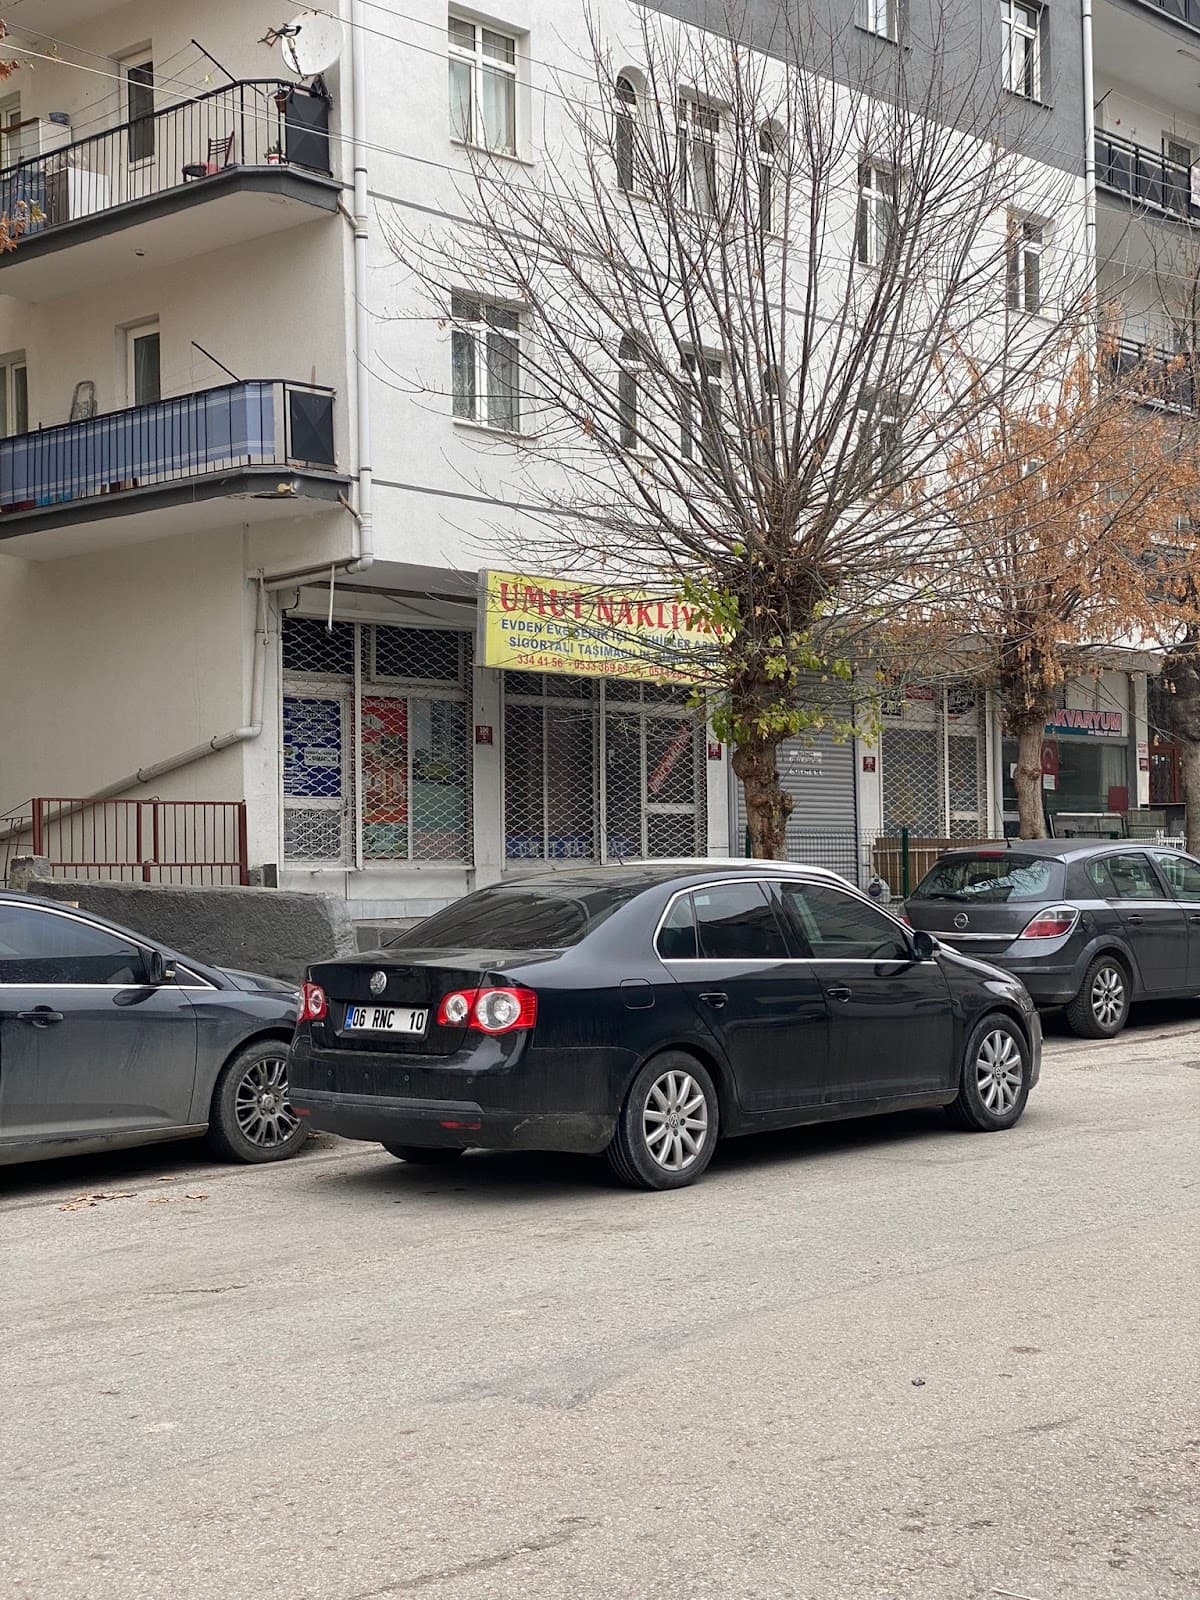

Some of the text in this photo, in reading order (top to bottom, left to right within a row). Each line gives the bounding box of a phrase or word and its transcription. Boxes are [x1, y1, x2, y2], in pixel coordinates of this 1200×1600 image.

[500, 582, 582, 619] UMUT
[501, 618, 542, 633] EVDEN
[547, 623, 569, 636] EVE
[509, 633, 574, 653] SİGORTALI
[517, 654, 535, 665] 334
[537, 655, 548, 666] 41
[552, 657, 563, 668] 56
[1046, 708, 1121, 731] AKVARYUM
[352, 1008, 425, 1031] 06 RNC 10
